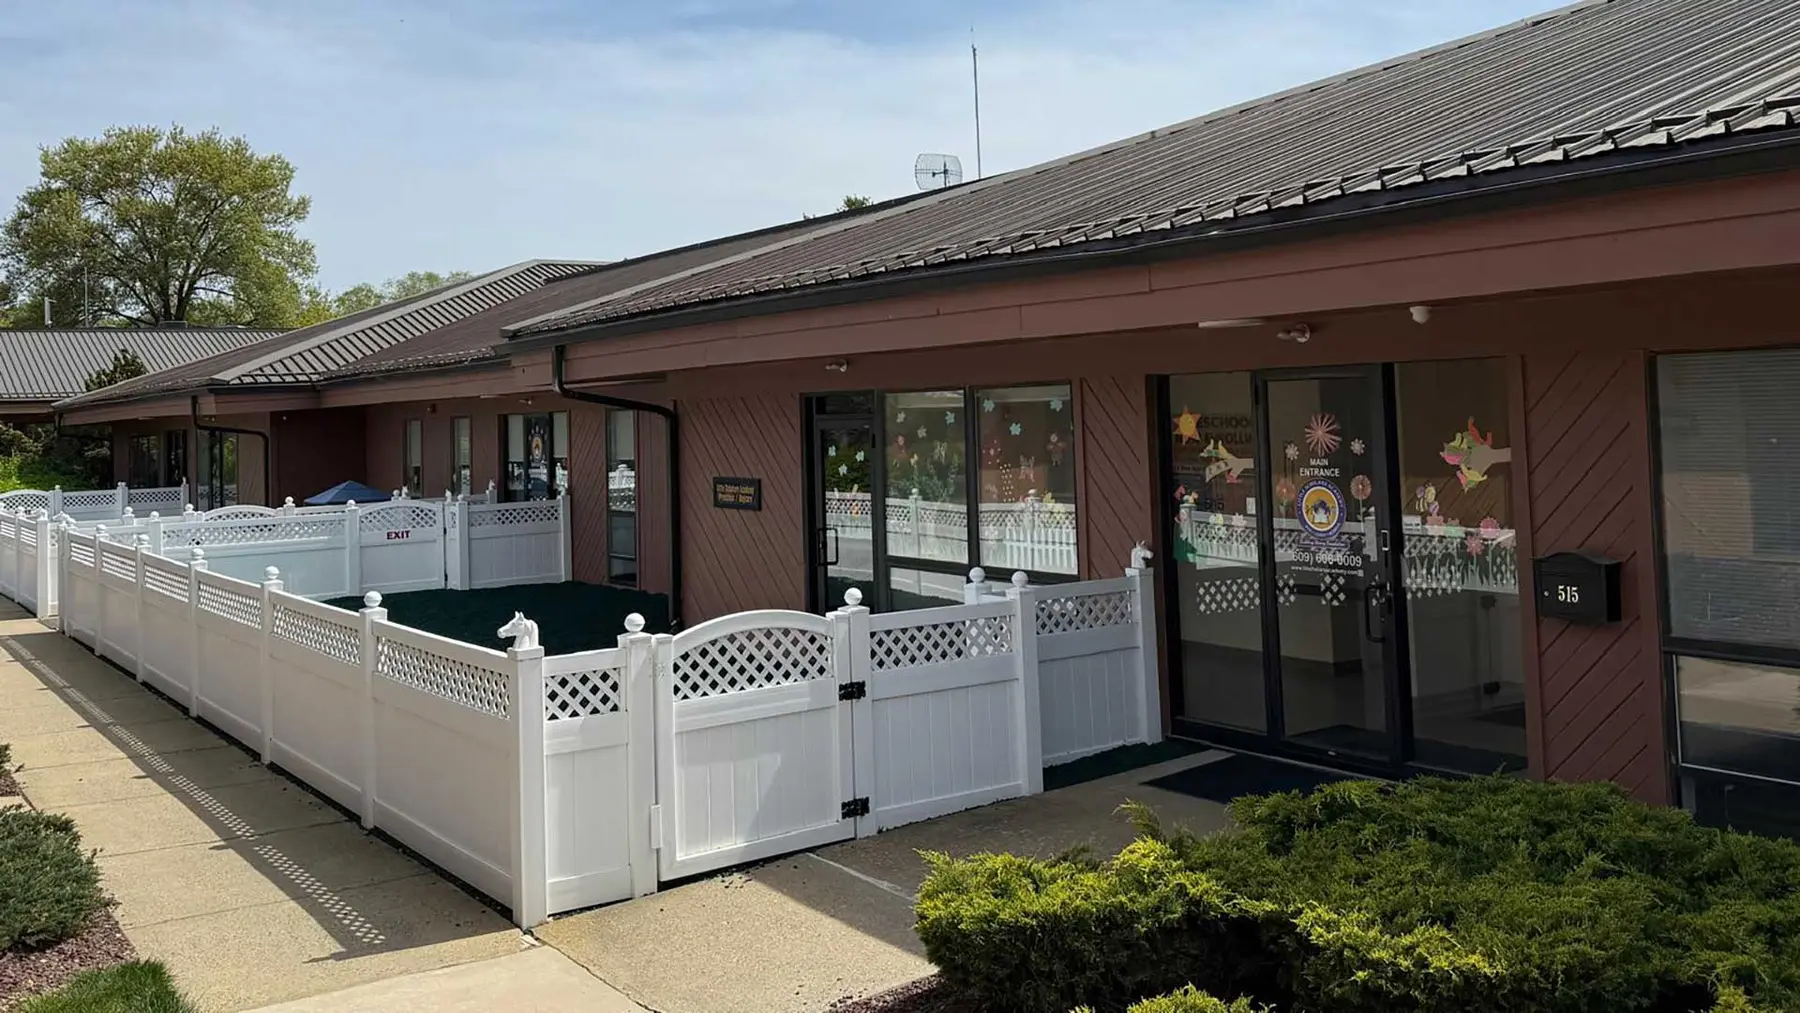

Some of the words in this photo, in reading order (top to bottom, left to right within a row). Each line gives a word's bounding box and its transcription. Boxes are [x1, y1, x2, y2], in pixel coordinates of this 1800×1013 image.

[1309, 457, 1329, 467] MAIN
[1299, 467, 1341, 478] ENTRANCE
[387, 530, 410, 540] EXIT
[1558, 585, 1579, 603] 515
